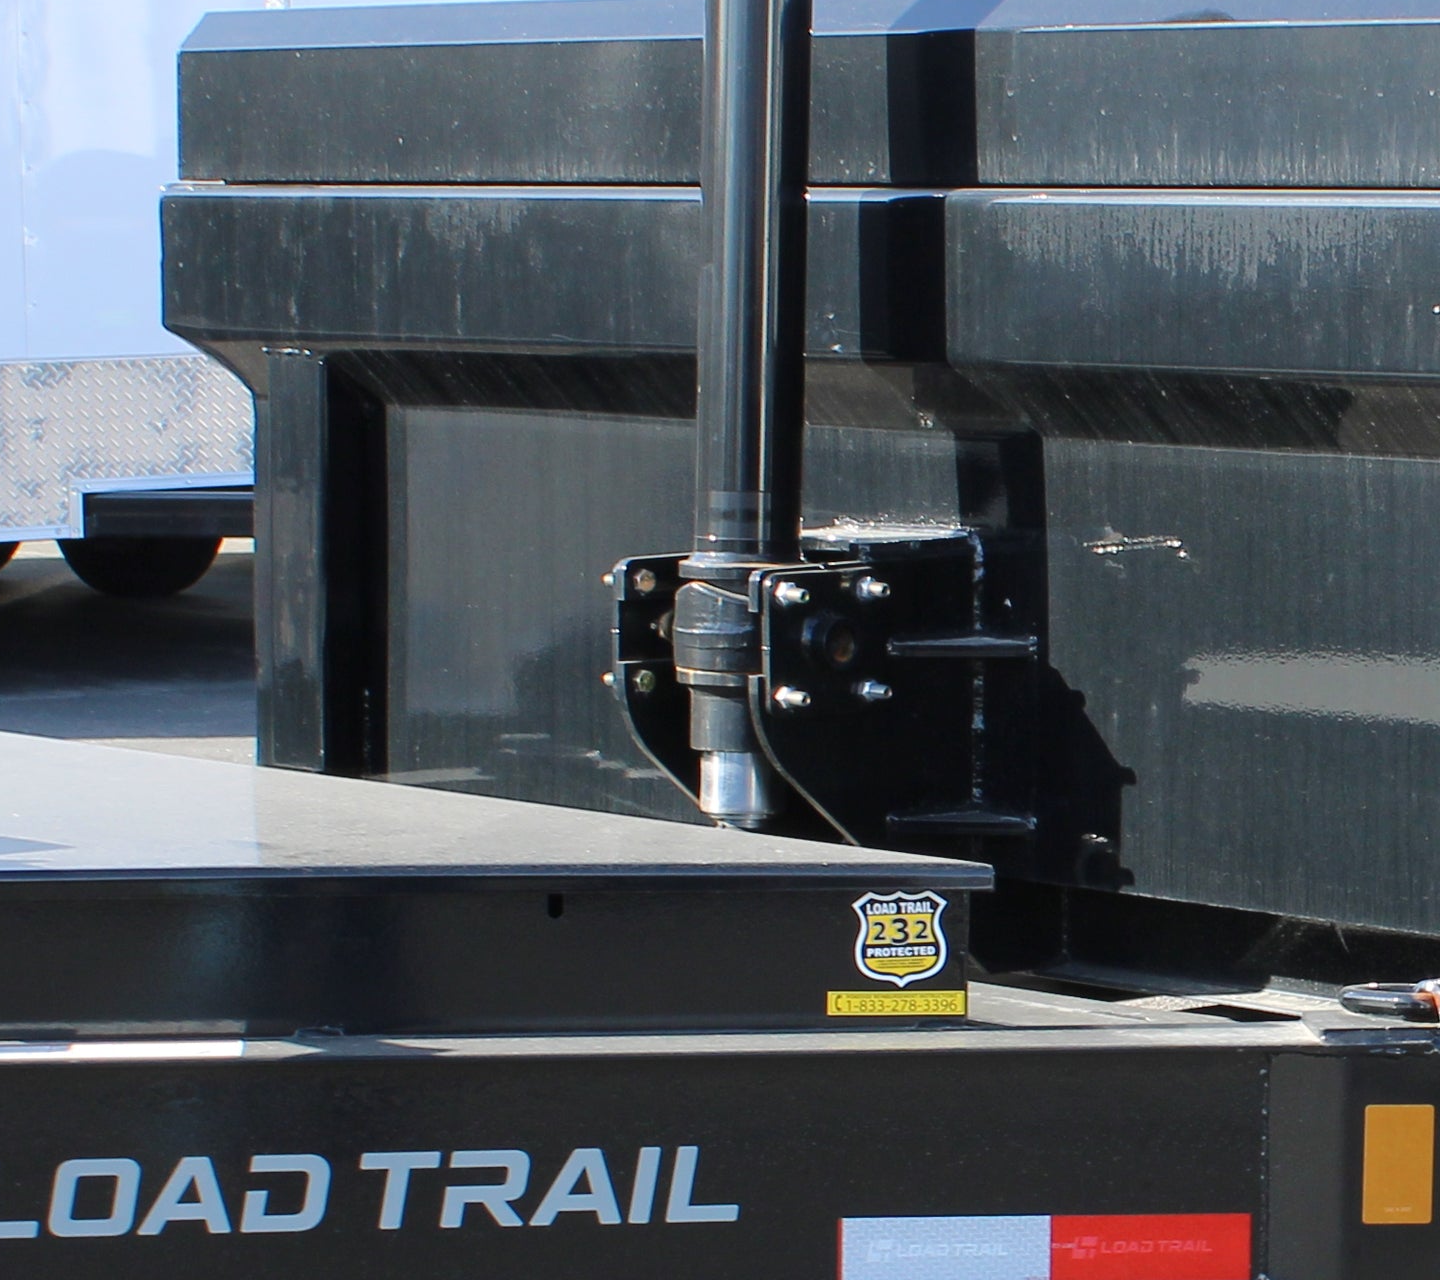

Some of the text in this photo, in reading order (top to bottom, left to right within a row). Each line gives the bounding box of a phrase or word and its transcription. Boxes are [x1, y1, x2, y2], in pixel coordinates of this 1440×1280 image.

[865, 900, 935, 916] LOAD TRAIL
[865, 945, 936, 958] PROTECTED
[846, 998, 959, 1014] 1-833-278-3396
[360, 1145, 739, 1230] TRAIL
[1101, 1239, 1213, 1254] LOAD TRAIL
